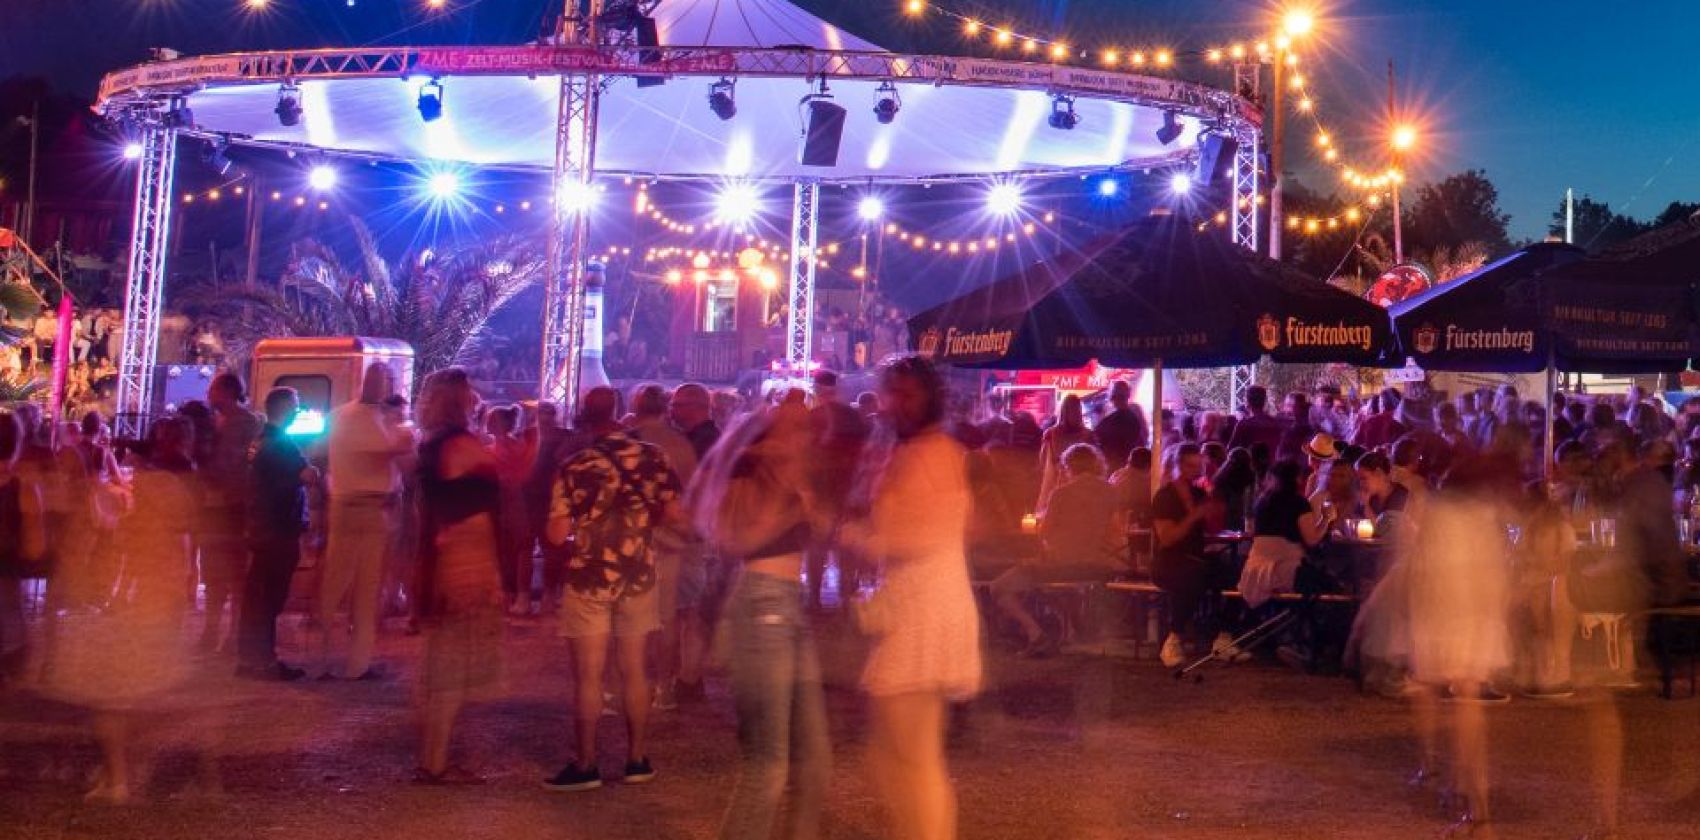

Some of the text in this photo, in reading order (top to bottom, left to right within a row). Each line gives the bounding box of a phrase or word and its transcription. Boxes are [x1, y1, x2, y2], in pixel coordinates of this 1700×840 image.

[1286, 316, 1372, 351] Fürstenberg
[1446, 323, 1533, 353] Fürstenberg
[1052, 375, 1080, 387] ZMF
